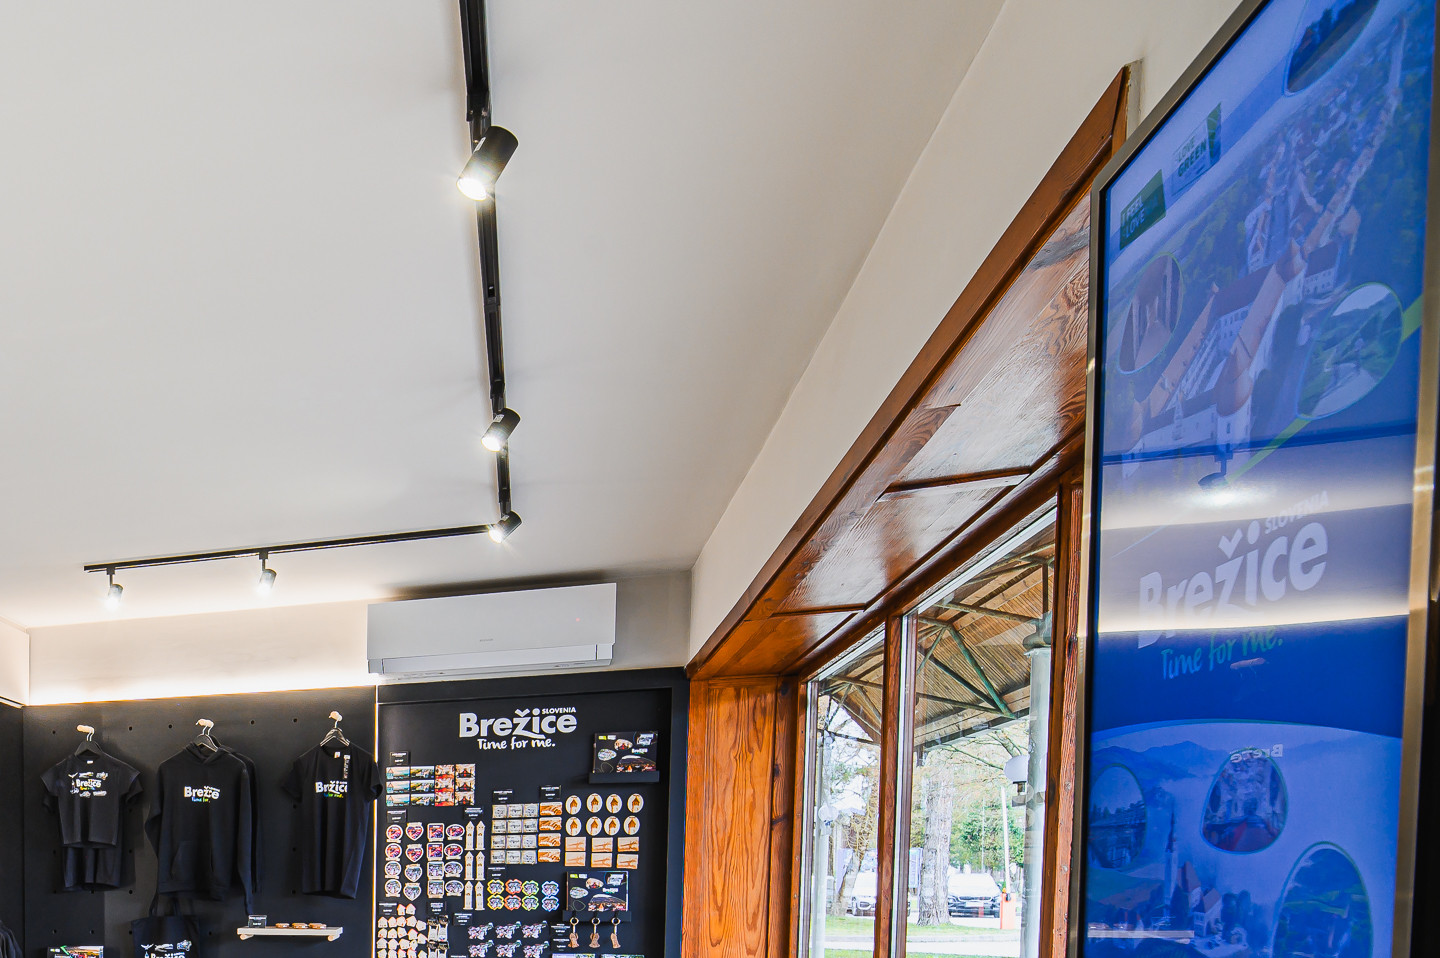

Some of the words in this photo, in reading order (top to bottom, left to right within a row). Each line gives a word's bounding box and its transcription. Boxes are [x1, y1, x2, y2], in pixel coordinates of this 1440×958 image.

[1264, 490, 1330, 534] SLOVENIA
[1137, 519, 1329, 649] Brežice
[1161, 648, 1202, 680] Time
[1208, 629, 1237, 672] for
[1241, 625, 1284, 657] me.
[459, 707, 578, 739] Brežice
[541, 706, 577, 715] SLOVENIA
[477, 738, 508, 750] Time
[510, 736, 529, 750] for
[531, 738, 556, 748] me.
